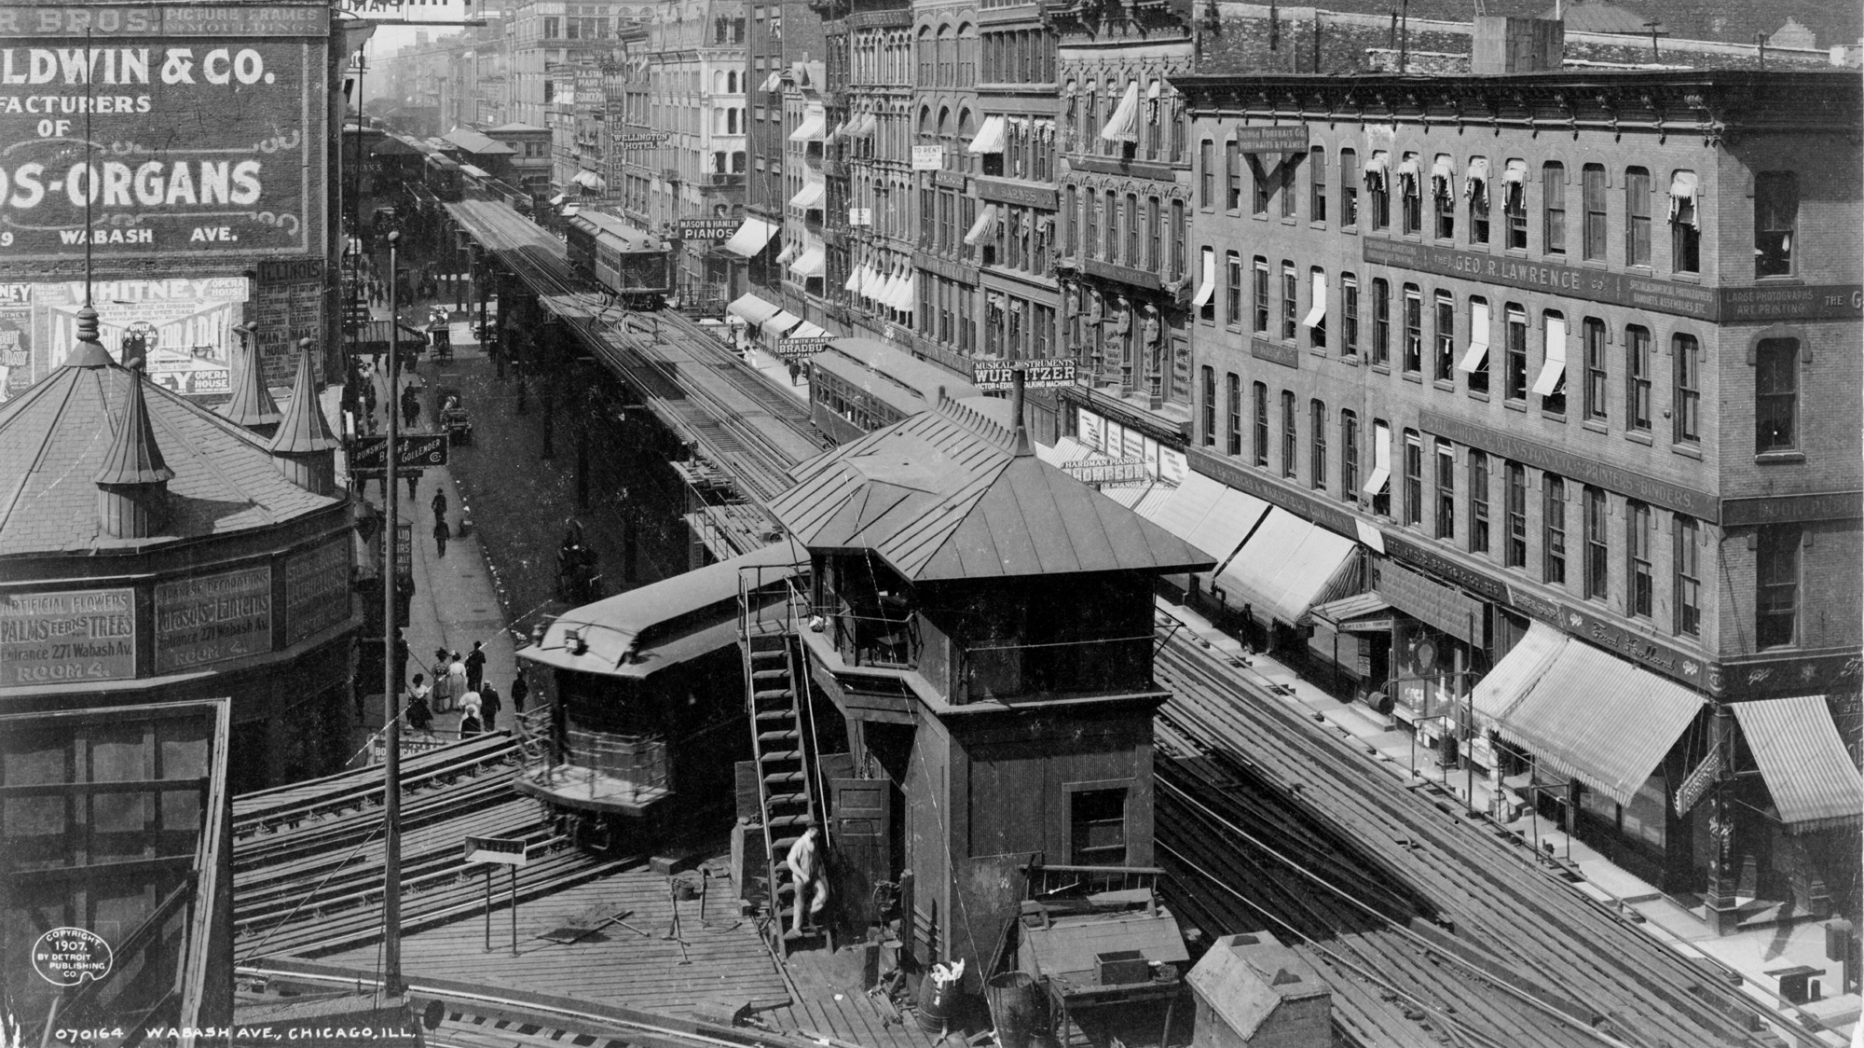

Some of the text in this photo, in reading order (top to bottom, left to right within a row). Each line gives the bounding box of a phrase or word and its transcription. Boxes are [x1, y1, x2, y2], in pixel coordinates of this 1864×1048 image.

[36, 9, 159, 32] BROS.
[166, 8, 318, 20] PICTURE FRAMES
[2, 47, 275, 85] LDWIN & CO.
[37, 119, 71, 138] OF
[613, 133, 670, 142] WELLINGTON
[680, 220, 739, 229] MASON & HAMLIN
[59, 228, 153, 245] WABASH
[190, 227, 239, 242] AVE.
[685, 228, 735, 239] PIANOS
[261, 262, 321, 281] ILLINOIS
[1434, 253, 1607, 292] THE GEO. R. LAWRENCE CO.
[211, 278, 245, 288] OPERA
[70, 279, 212, 304] WHITNEY
[211, 287, 245, 297] HOUSE
[1726, 289, 1814, 303] LARGE PHOTOGRAPHS
[1825, 295, 1844, 306] THE
[1737, 303, 1805, 315] ART PRINTING
[129, 323, 151, 331] ONLY
[259, 332, 279, 344] MAN
[264, 344, 289, 356] HOUR
[779, 344, 824, 353] BRADBU
[975, 359, 1075, 370] MUSICAL STRUMENTS
[194, 370, 228, 380] OPERA
[974, 366, 1076, 383] WURITZER
[194, 379, 228, 388] HOUSE
[974, 382, 996, 390] VICTOR
[1024, 381, 1045, 389] ALKING
[1065, 457, 1140, 468] HARDMAN PIANOS
[1640, 481, 1694, 509] BINDERS.
[205, 573, 270, 597] DECORATIONS
[1, 593, 128, 616] ARTIFICIAL FLOWERS
[0, 618, 49, 643] PALMS
[49, 617, 88, 636] FERNS
[88, 614, 133, 639] TREES
[158, 632, 199, 651] Entrance
[200, 625, 217, 641] 271
[217, 618, 254, 637] Wabash
[1, 640, 133, 662] Entrance 271 Wabash Av.
[1593, 621, 1676, 672] Fred Holland
[174, 645, 222, 666] ROOM
[18, 662, 84, 681] ROOM
